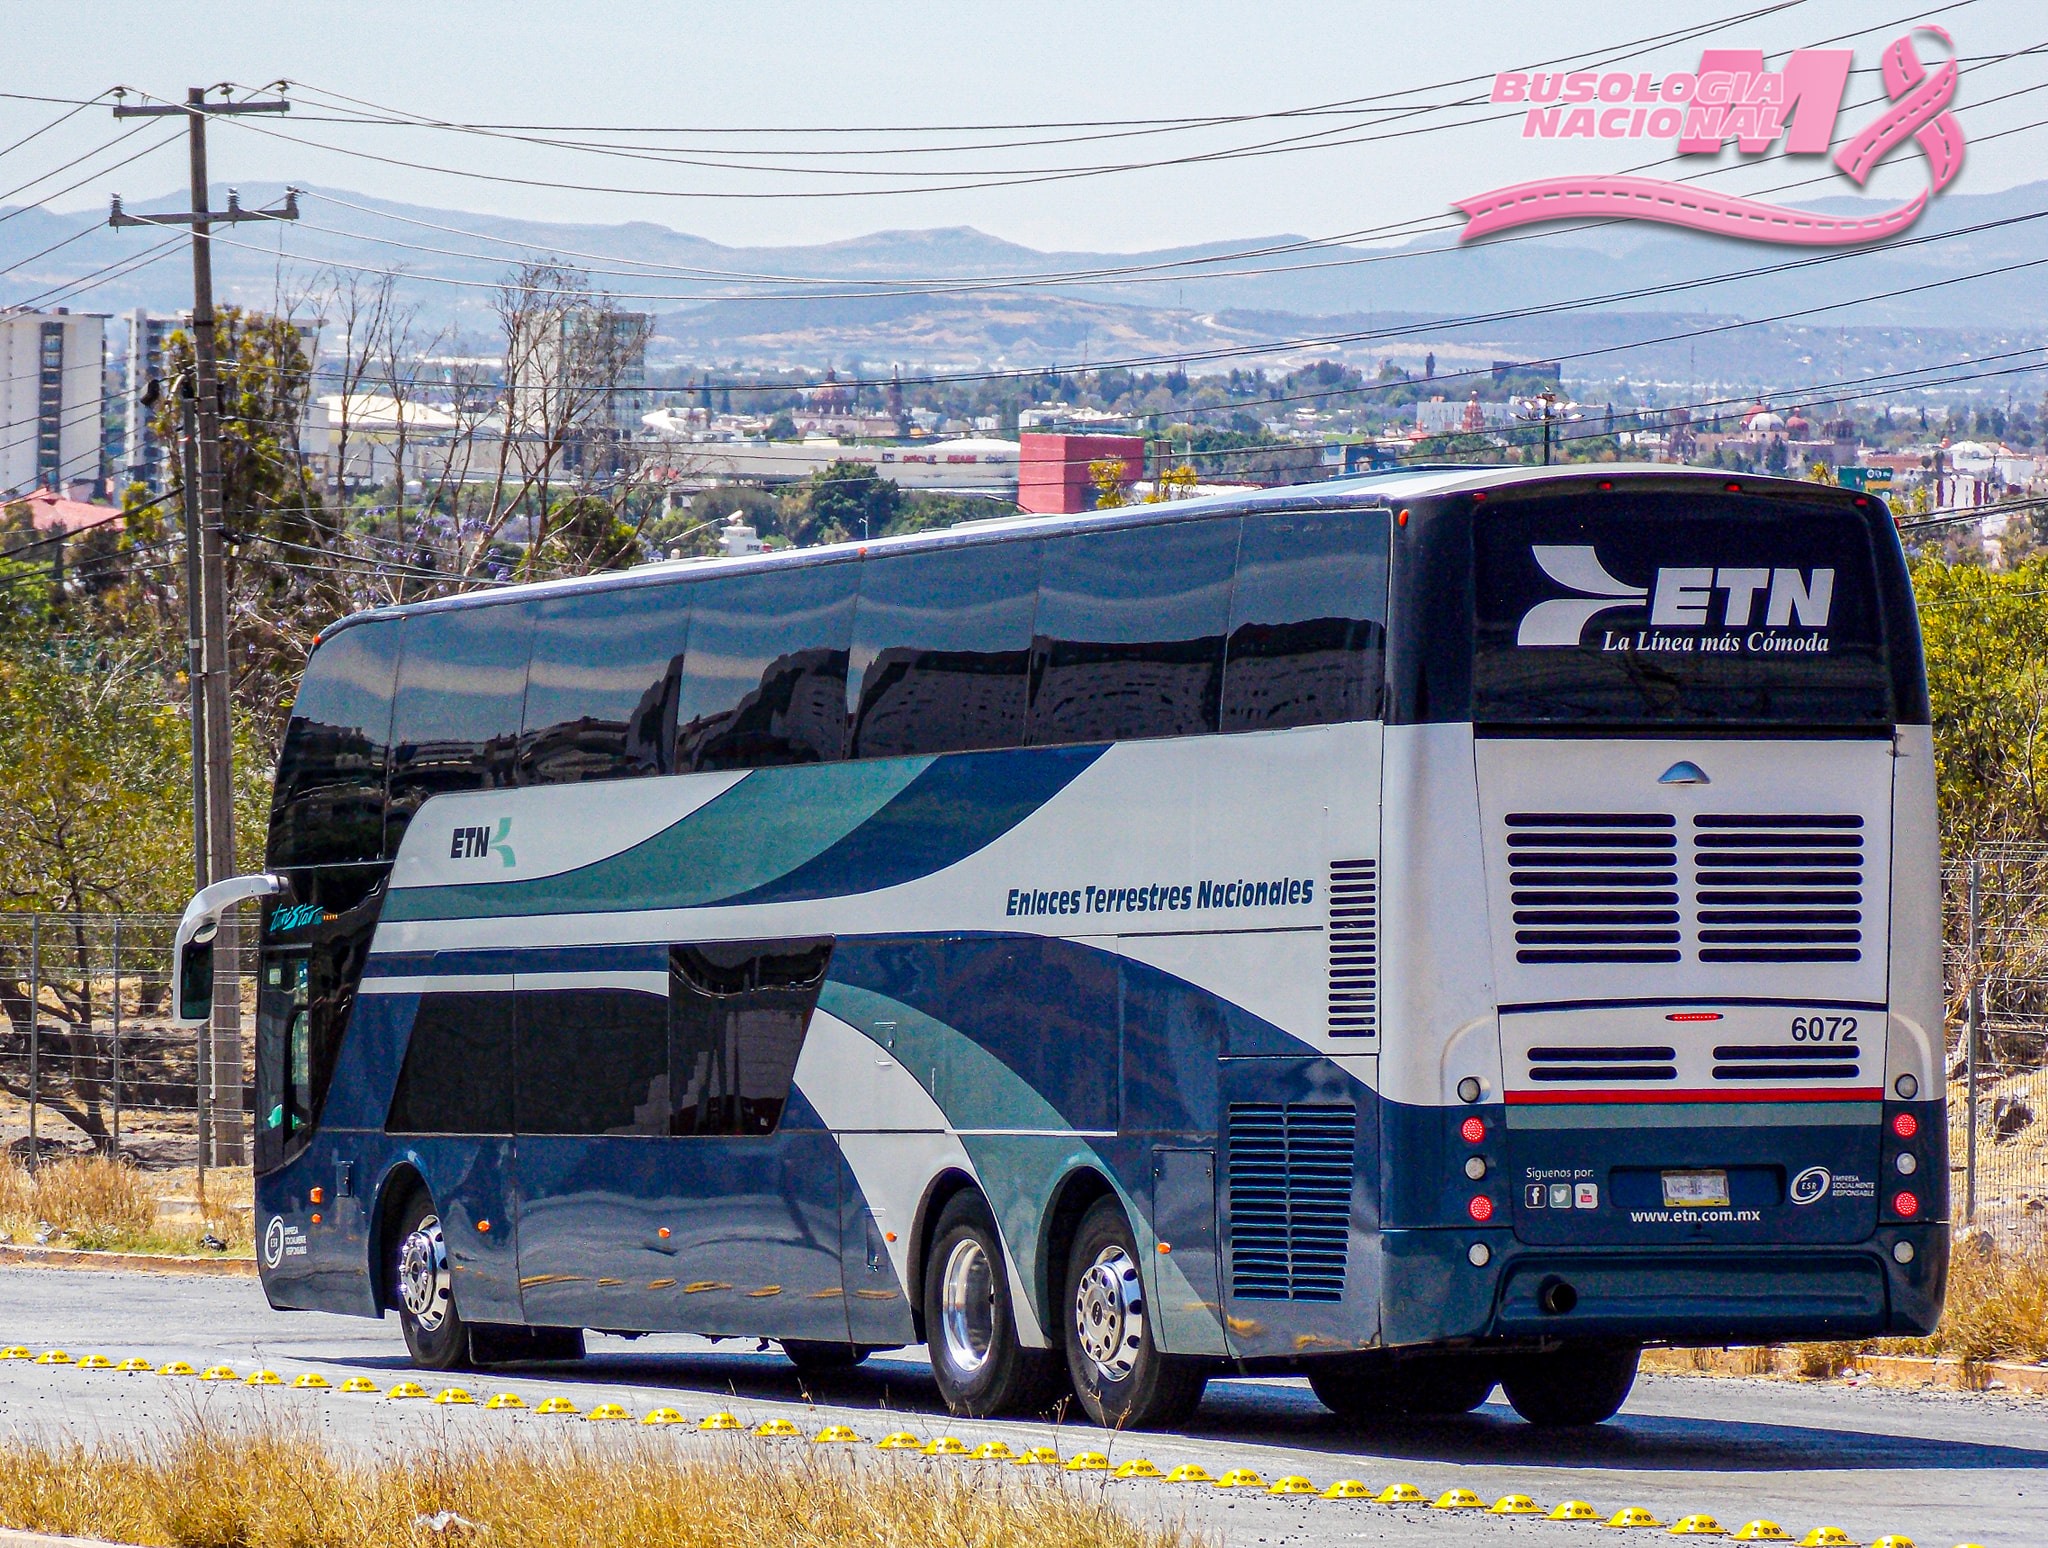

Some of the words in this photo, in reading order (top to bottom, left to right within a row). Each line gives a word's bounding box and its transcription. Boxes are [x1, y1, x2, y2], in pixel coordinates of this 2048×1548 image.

[1651, 567, 1836, 627] ETN
[1602, 631, 1630, 651] La
[1636, 631, 1694, 652] Línea
[1700, 633, 1741, 652] más
[1747, 630, 1829, 652] Cómoda
[450, 826, 491, 859] ETN
[1005, 888, 1081, 916] Enlaces
[1085, 882, 1192, 914] Terrestres
[1196, 877, 1314, 910] Nacionales
[1791, 1017, 1858, 1042] 6072
[1801, 1182, 1817, 1190] ESR
[1630, 1210, 1761, 1222] www.etn.com.mx
